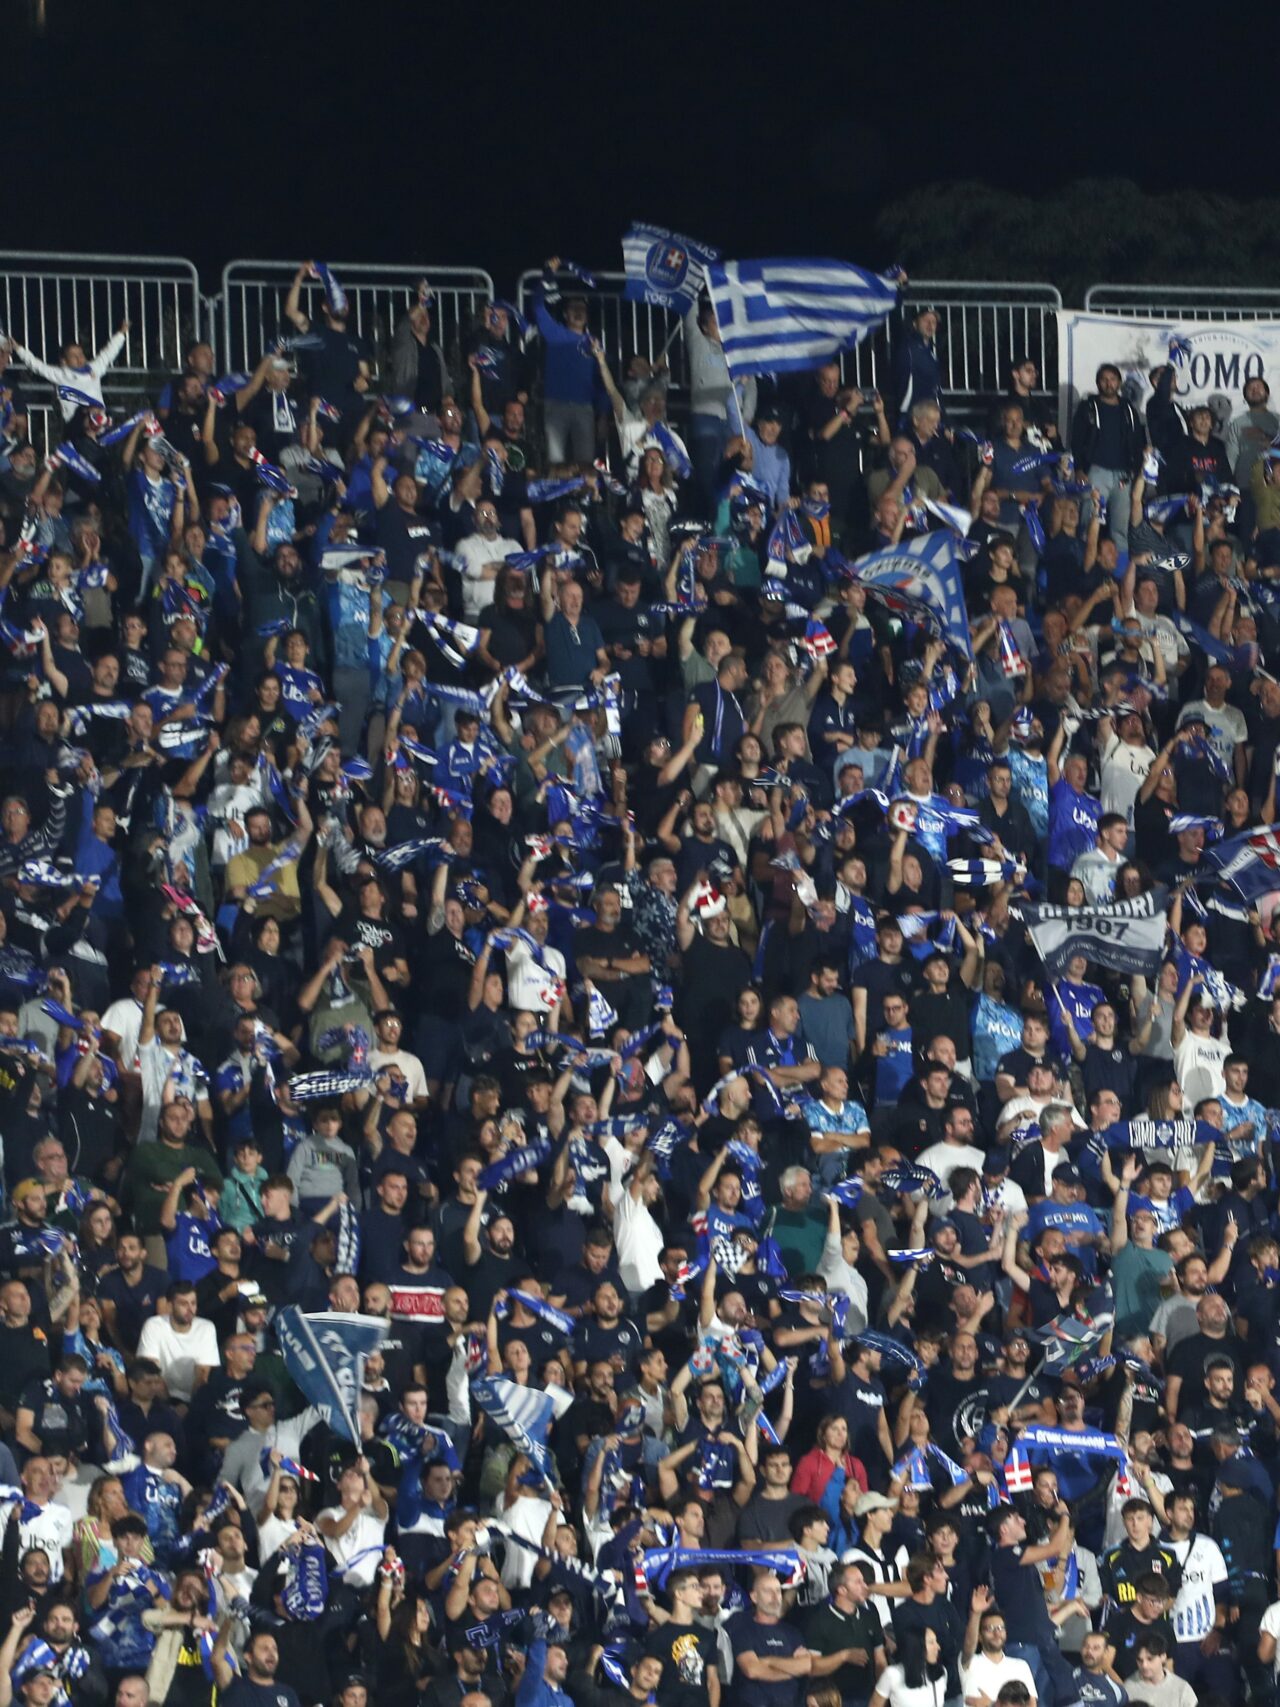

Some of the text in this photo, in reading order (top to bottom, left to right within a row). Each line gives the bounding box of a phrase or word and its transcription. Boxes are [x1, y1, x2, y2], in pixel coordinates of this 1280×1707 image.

[1064, 916, 1134, 940] 1907
[189, 1234, 212, 1258] Ub
[18, 1532, 61, 1551] Uber
